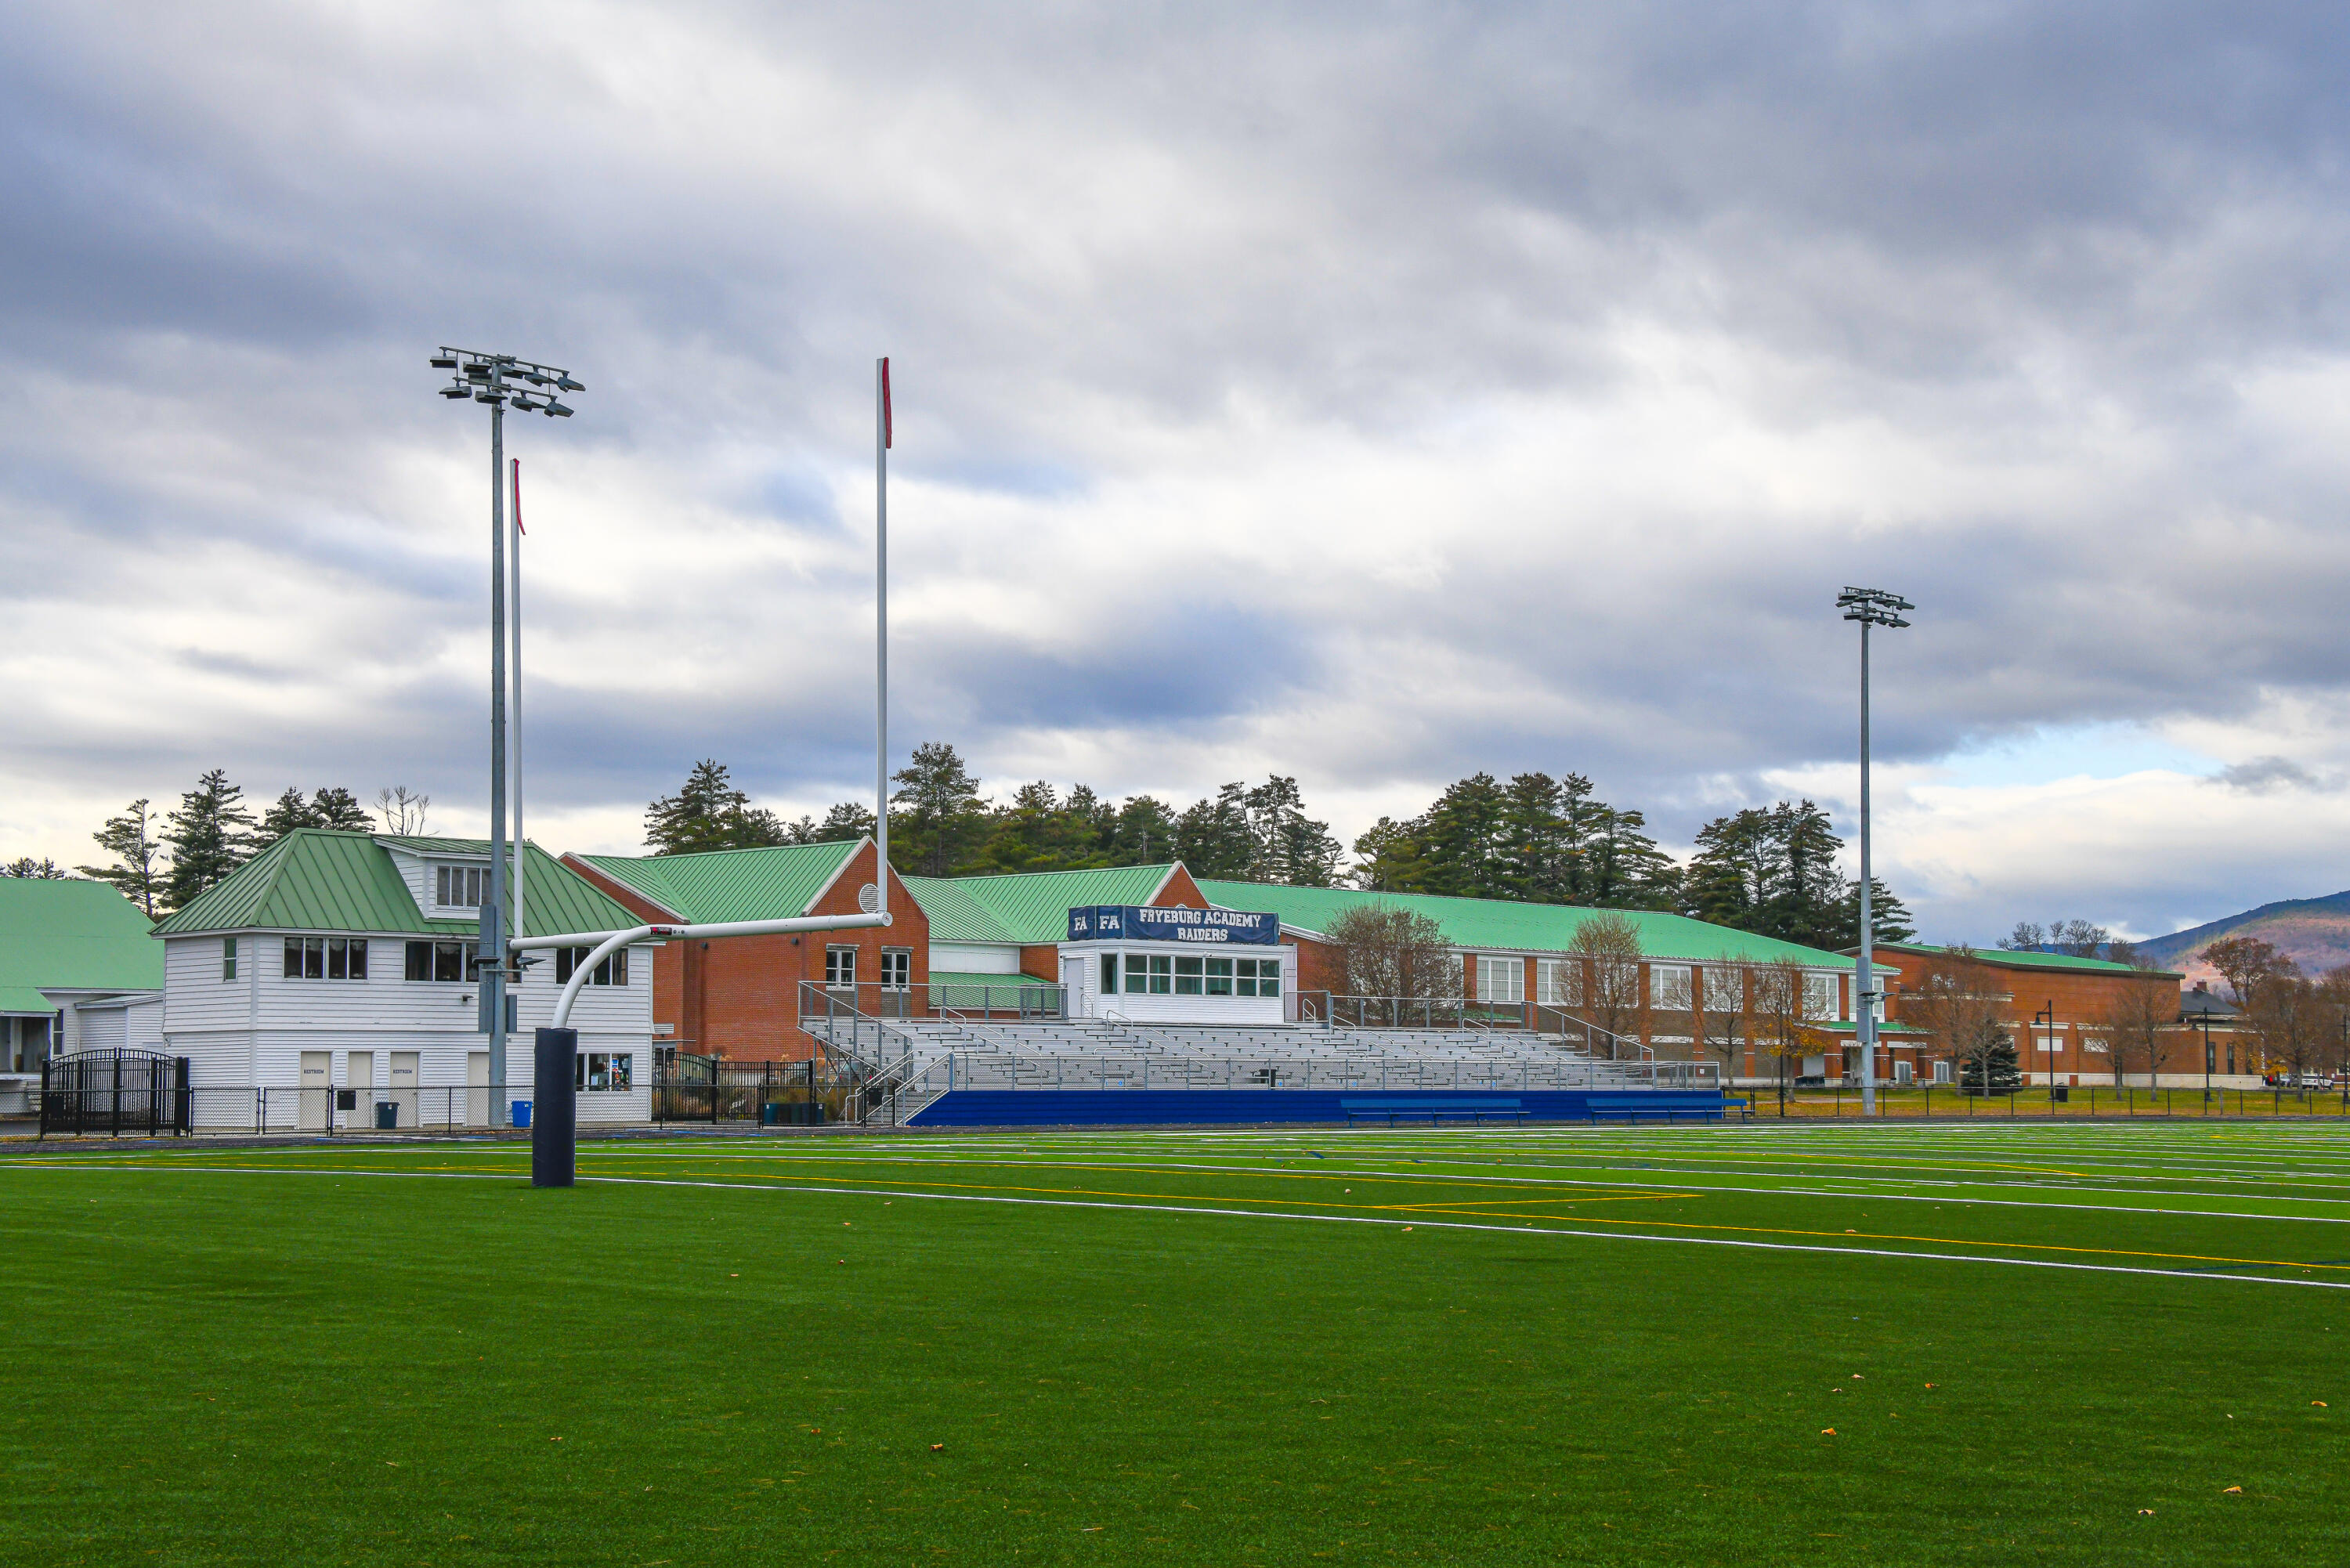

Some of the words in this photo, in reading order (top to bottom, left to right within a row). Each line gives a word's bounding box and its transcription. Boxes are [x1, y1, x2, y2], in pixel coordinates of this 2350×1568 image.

[1074, 916, 1087, 931] FA
[1099, 915, 1120, 930] FA
[1139, 909, 1202, 924] FRYEBURG
[1204, 911, 1261, 928] ACADEMY
[1177, 927, 1228, 941] RAIDERS
